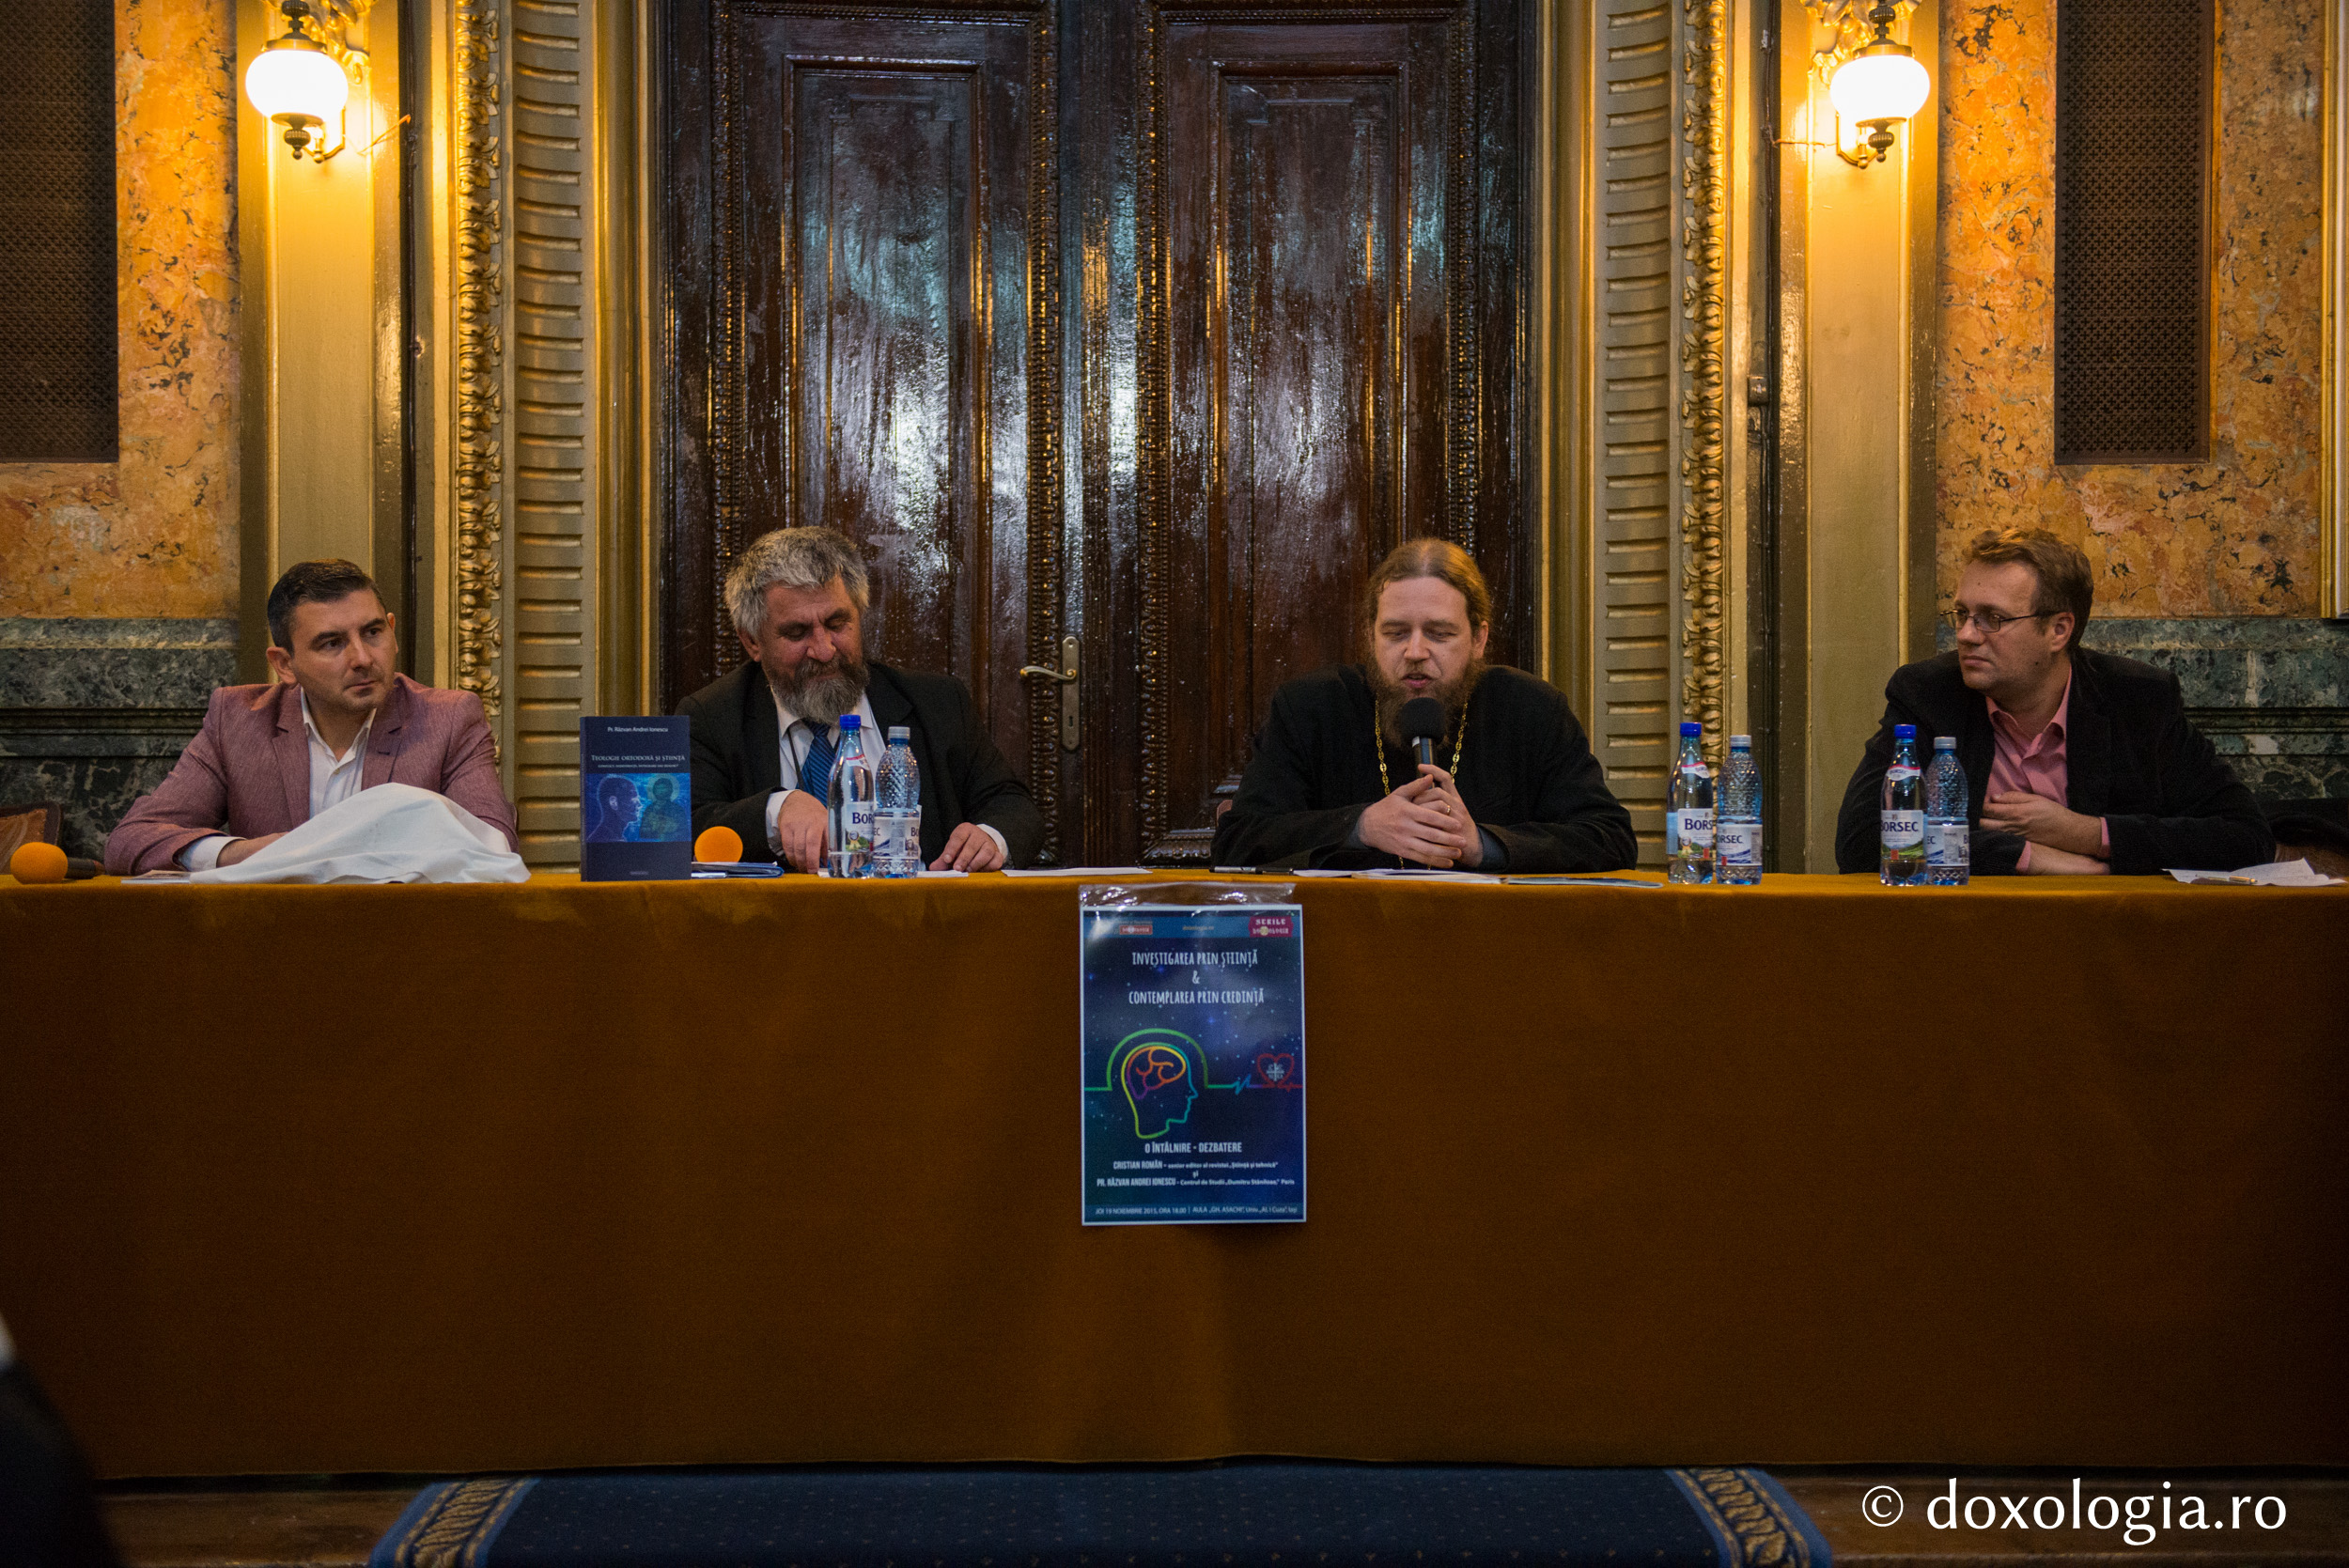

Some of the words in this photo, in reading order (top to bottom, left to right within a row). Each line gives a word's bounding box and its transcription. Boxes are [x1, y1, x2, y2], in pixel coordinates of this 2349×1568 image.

[1132, 952, 1194, 965] INVESTIGAREA
[1197, 952, 1218, 965] PRIN
[1192, 970, 1200, 984] &
[1129, 991, 1194, 1004] CONTEMPLAREA
[1198, 991, 1219, 1004] PRIN
[1145, 1143, 1150, 1154] O
[1199, 1142, 1242, 1153] DEZBATERE
[1113, 1161, 1140, 1170] CRISTIAN
[1097, 1178, 1106, 1187] PR.
[1131, 1178, 1151, 1186] ANDREI
[1152, 1178, 1176, 1186] IONESCU
